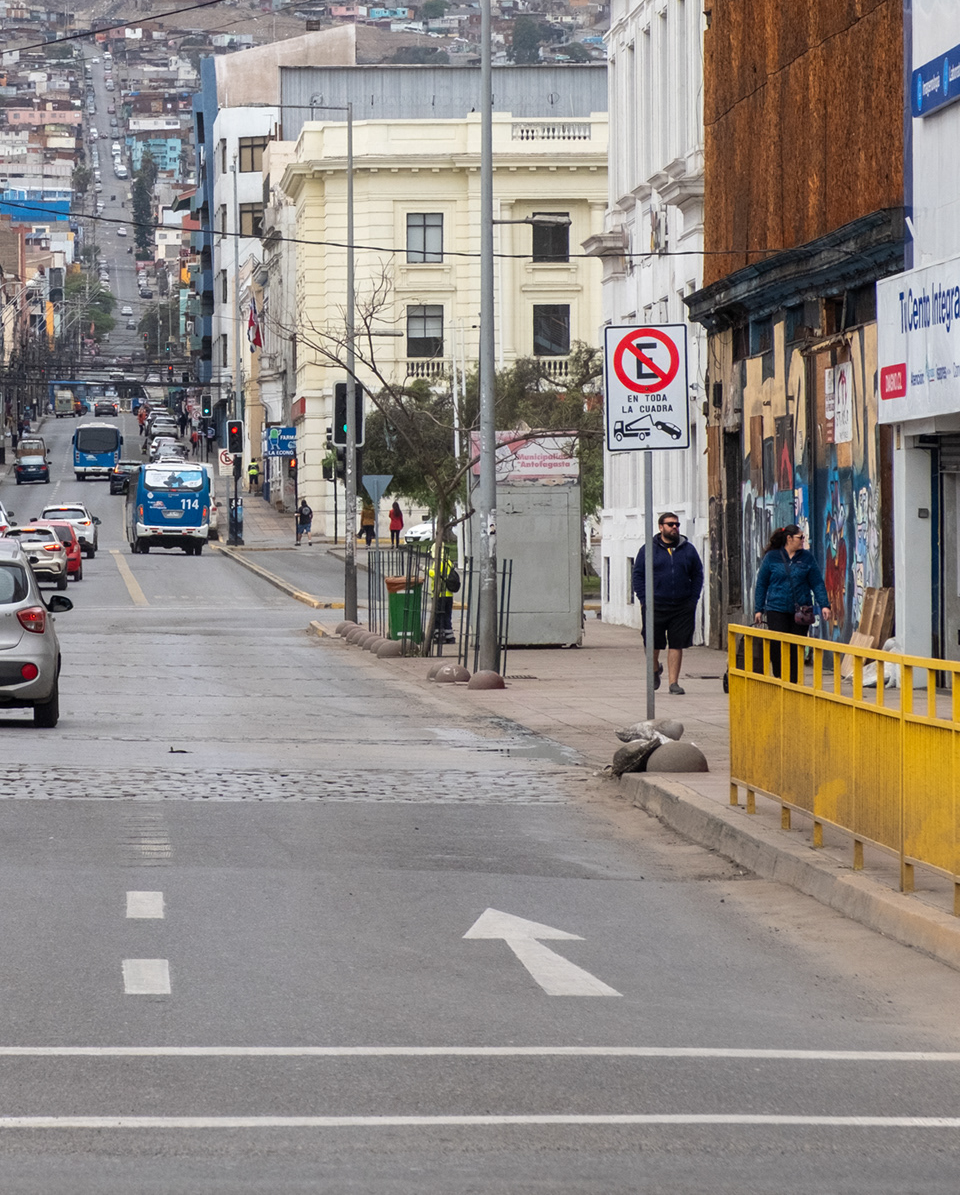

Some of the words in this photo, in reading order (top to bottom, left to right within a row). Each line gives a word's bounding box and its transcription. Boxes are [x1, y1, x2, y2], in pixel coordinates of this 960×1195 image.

[627, 394, 639, 403] EN
[645, 394, 668, 402] TODA
[622, 406, 633, 414] LA
[640, 404, 674, 413] CUADRA
[180, 498, 200, 510] 114
